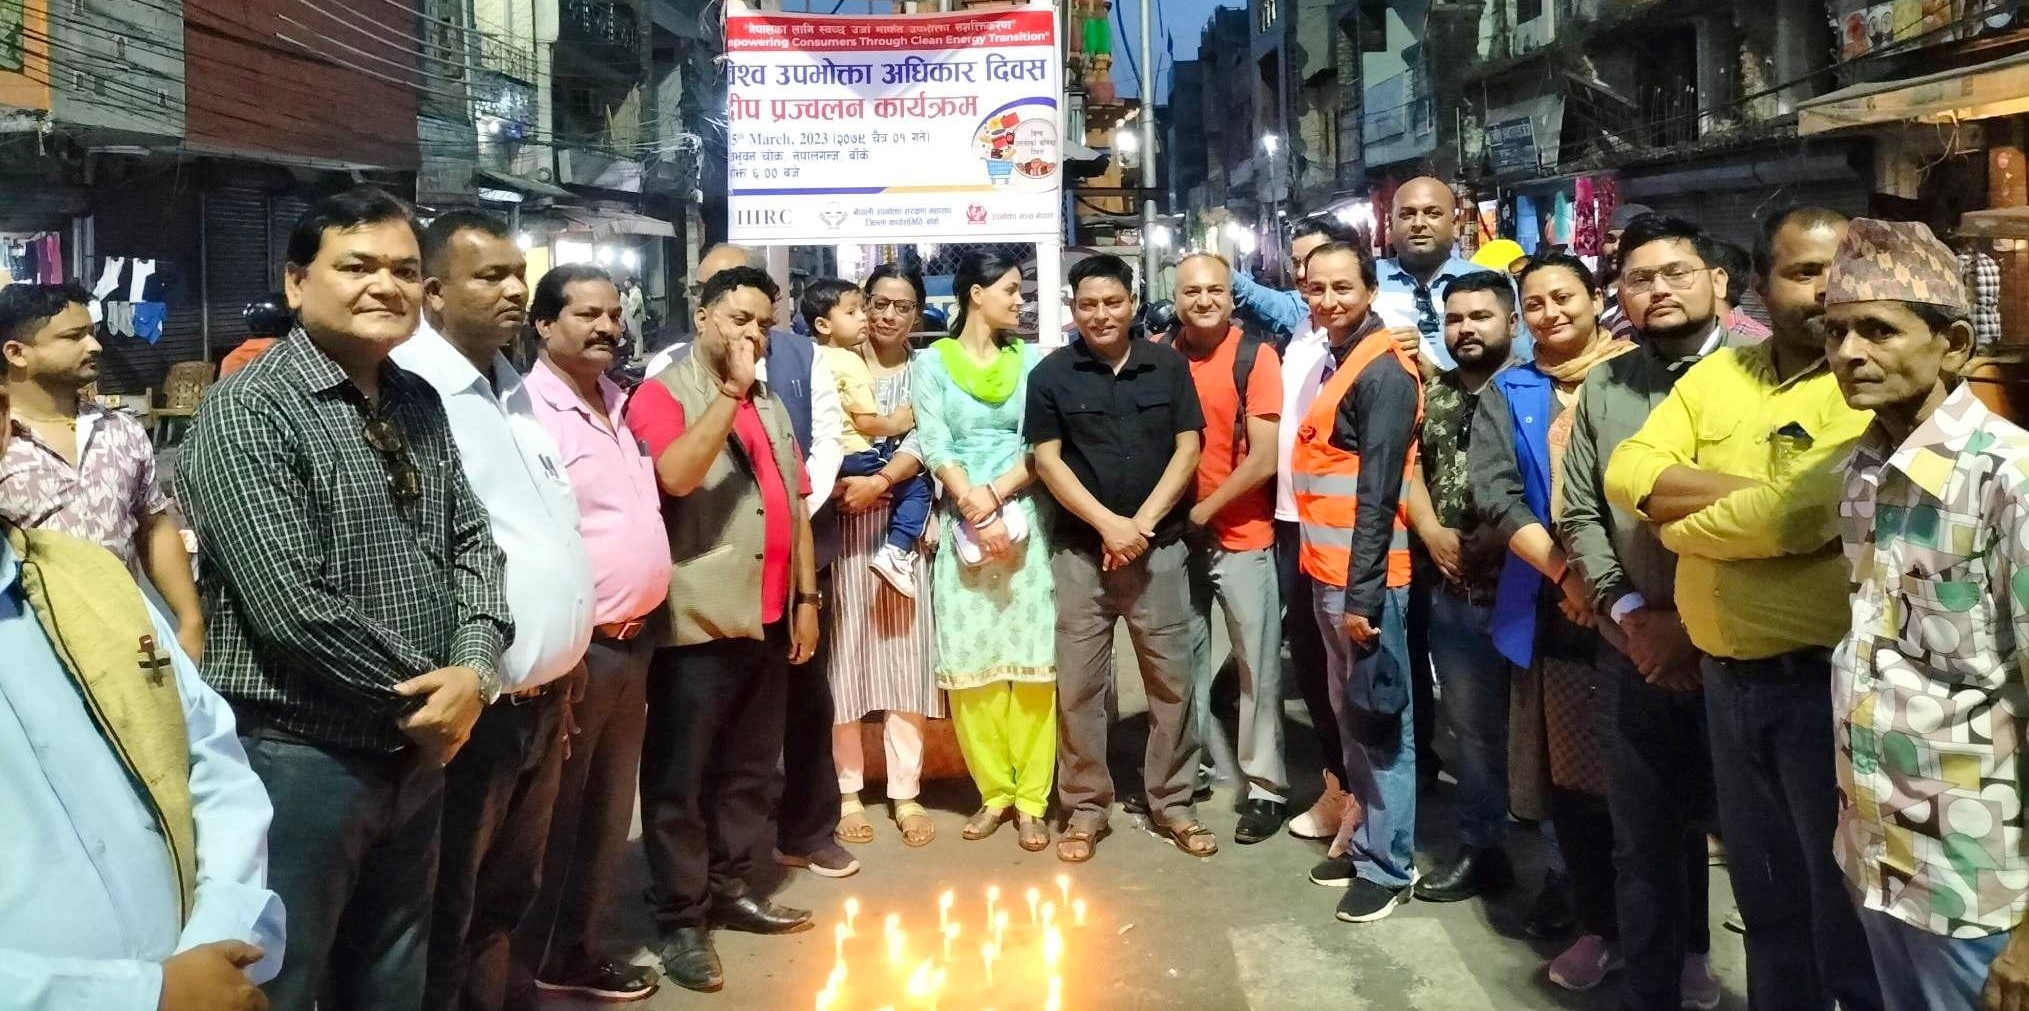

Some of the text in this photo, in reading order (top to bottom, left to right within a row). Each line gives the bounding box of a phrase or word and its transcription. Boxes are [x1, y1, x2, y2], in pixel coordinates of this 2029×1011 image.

[791, 37, 857, 47] Consumers
[859, 36, 908, 47] Through
[910, 35, 943, 45] Clean
[945, 34, 986, 46] Energy
[775, 57, 873, 86] उपभोक्ता
[881, 55, 978, 84] अधिकार
[986, 53, 1047, 82] दिवस
[770, 98, 866, 123] प्रज्वलन
[873, 91, 979, 121] कार्यक्रम
[800, 131, 829, 145] 2023
[783, 165, 801, 177] बजे
